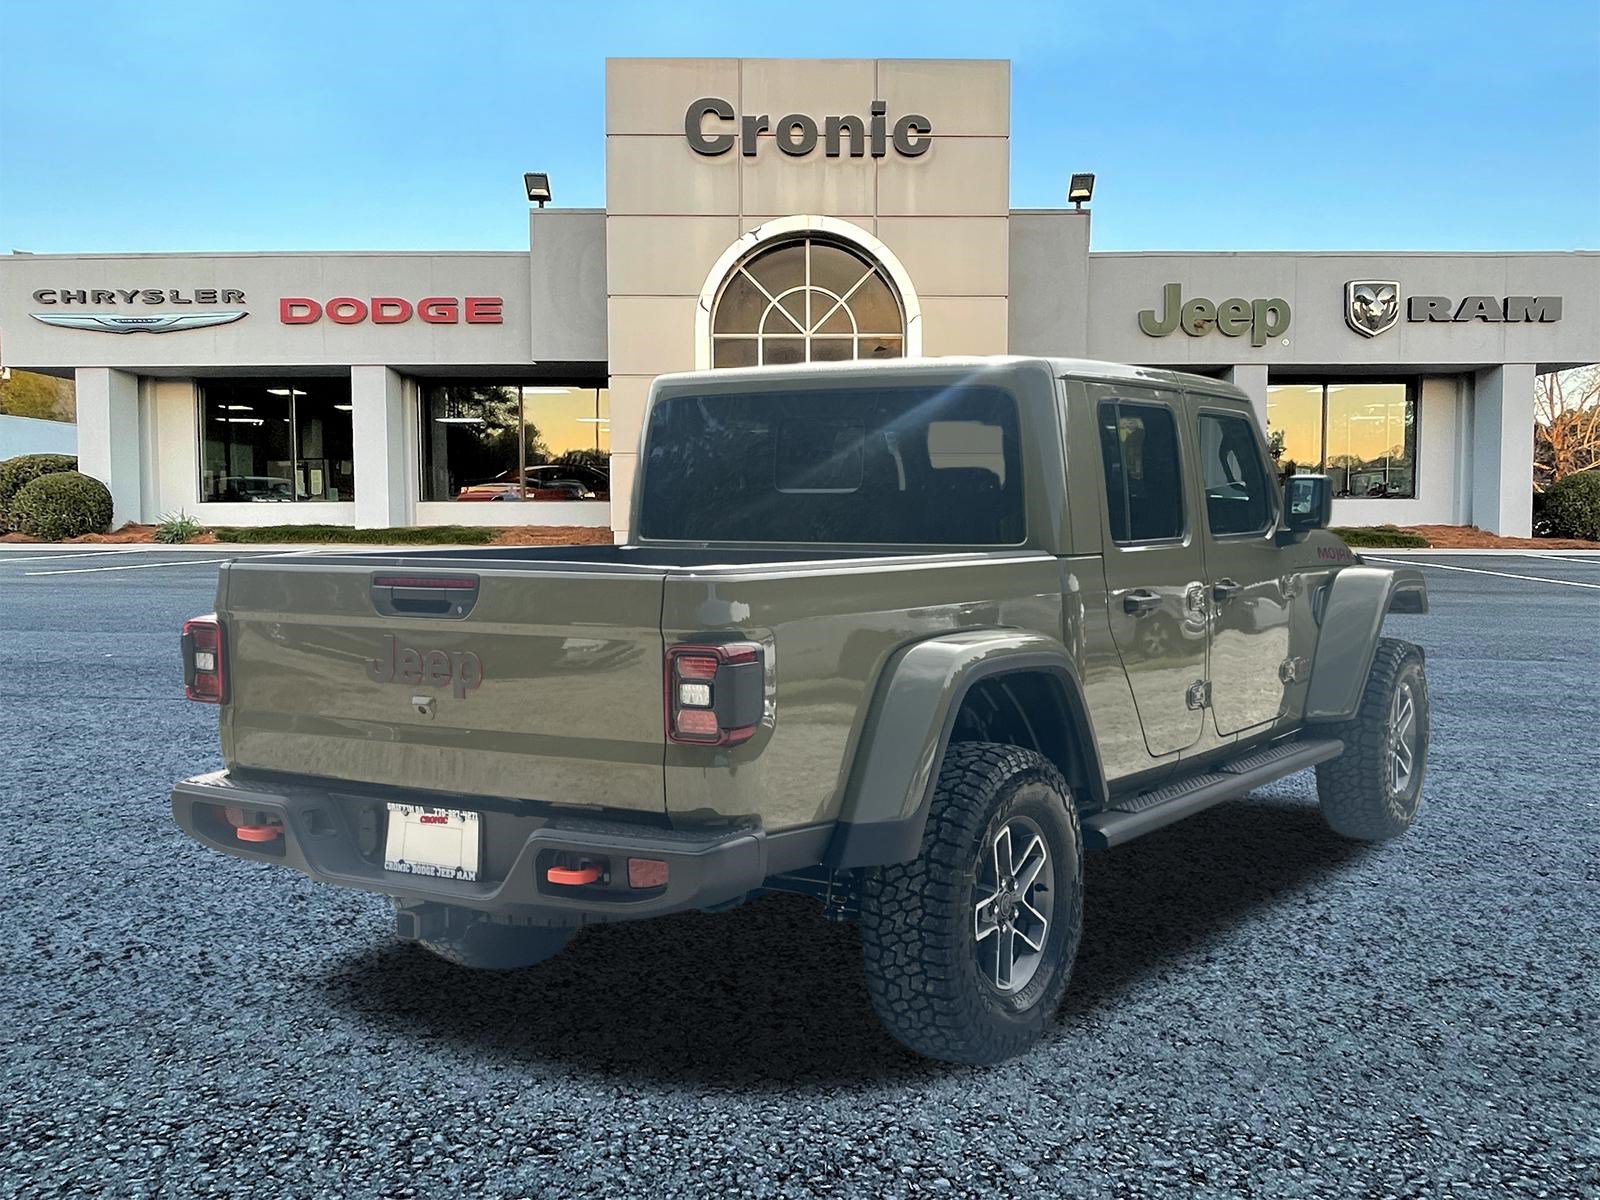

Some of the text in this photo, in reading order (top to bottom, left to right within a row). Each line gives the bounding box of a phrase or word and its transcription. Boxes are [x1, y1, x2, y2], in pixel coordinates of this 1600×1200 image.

[685, 97, 932, 157] Cronic
[32, 287, 247, 305] CHRYSLER
[1407, 296, 1562, 323] RAM
[279, 297, 503, 325] DODGE
[1138, 283, 1291, 347] Jeep
[366, 633, 483, 699] Jeep
[436, 868, 456, 879] JEEP
